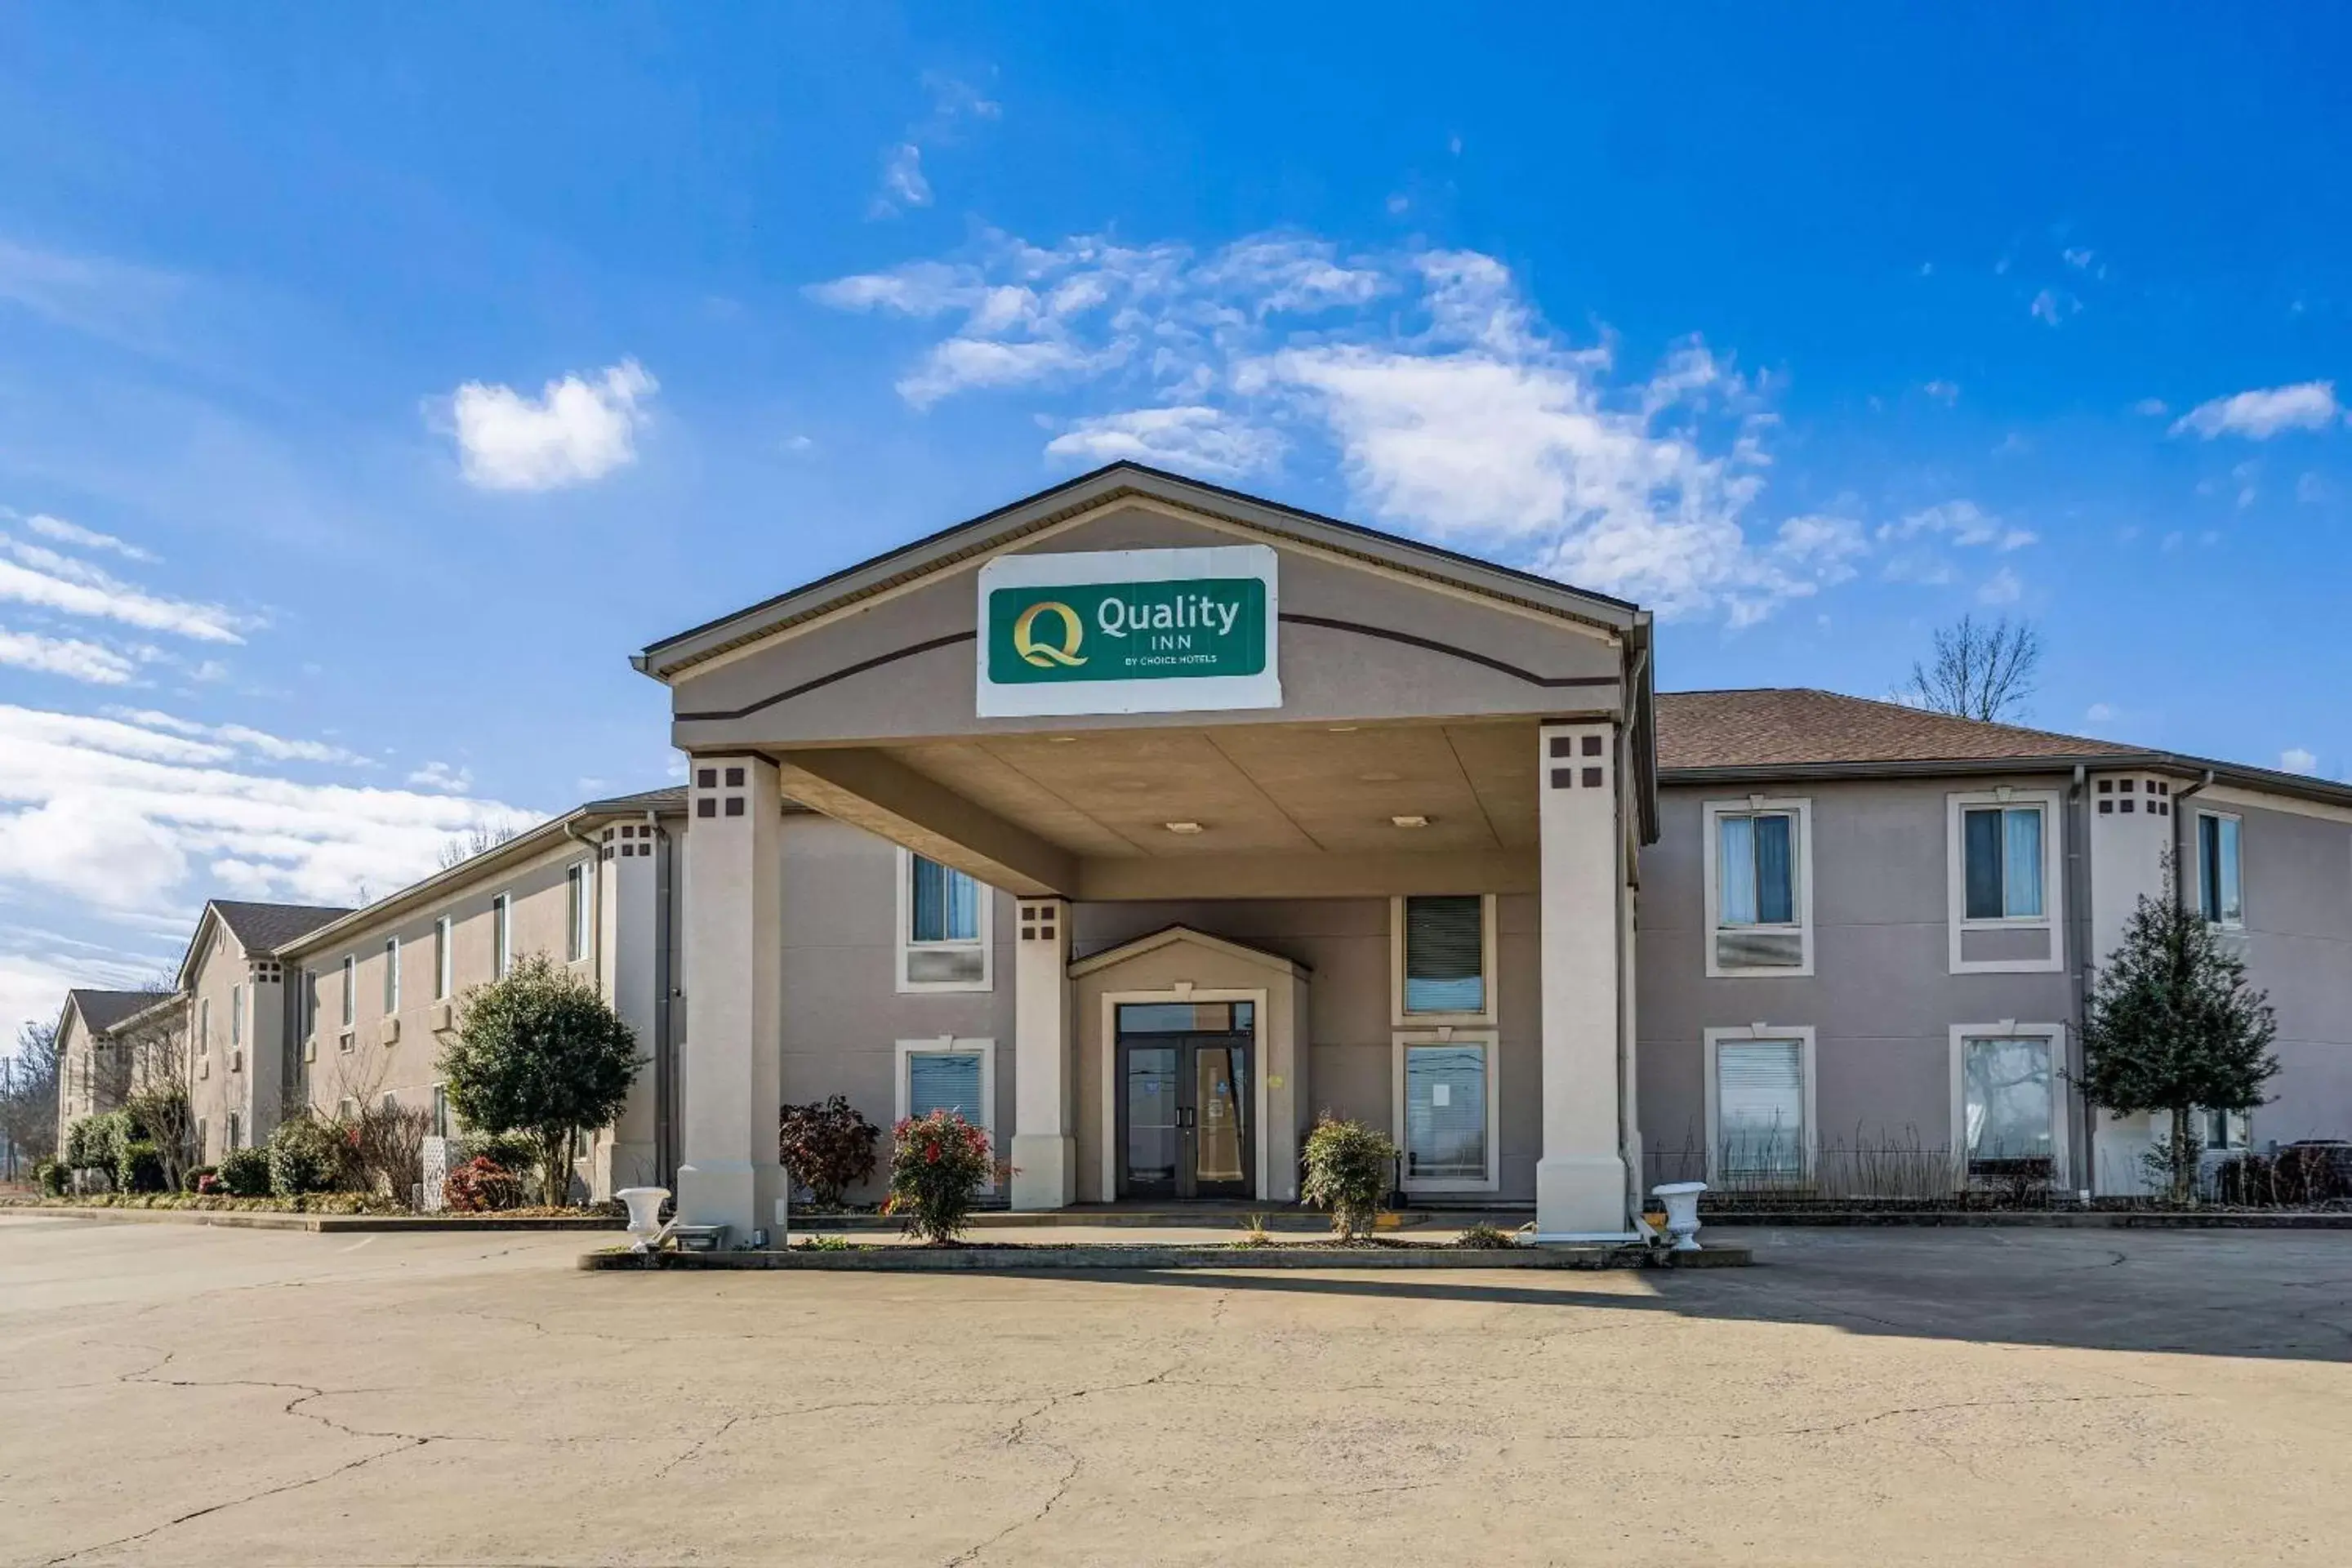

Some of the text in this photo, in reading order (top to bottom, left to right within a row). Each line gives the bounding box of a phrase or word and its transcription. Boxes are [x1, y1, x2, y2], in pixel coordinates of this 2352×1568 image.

[1098, 595, 1240, 638] Quality
[1013, 601, 1089, 667] Q
[1152, 635, 1191, 650] INN
[1125, 654, 1218, 666] BY CHOICE HOTELS
